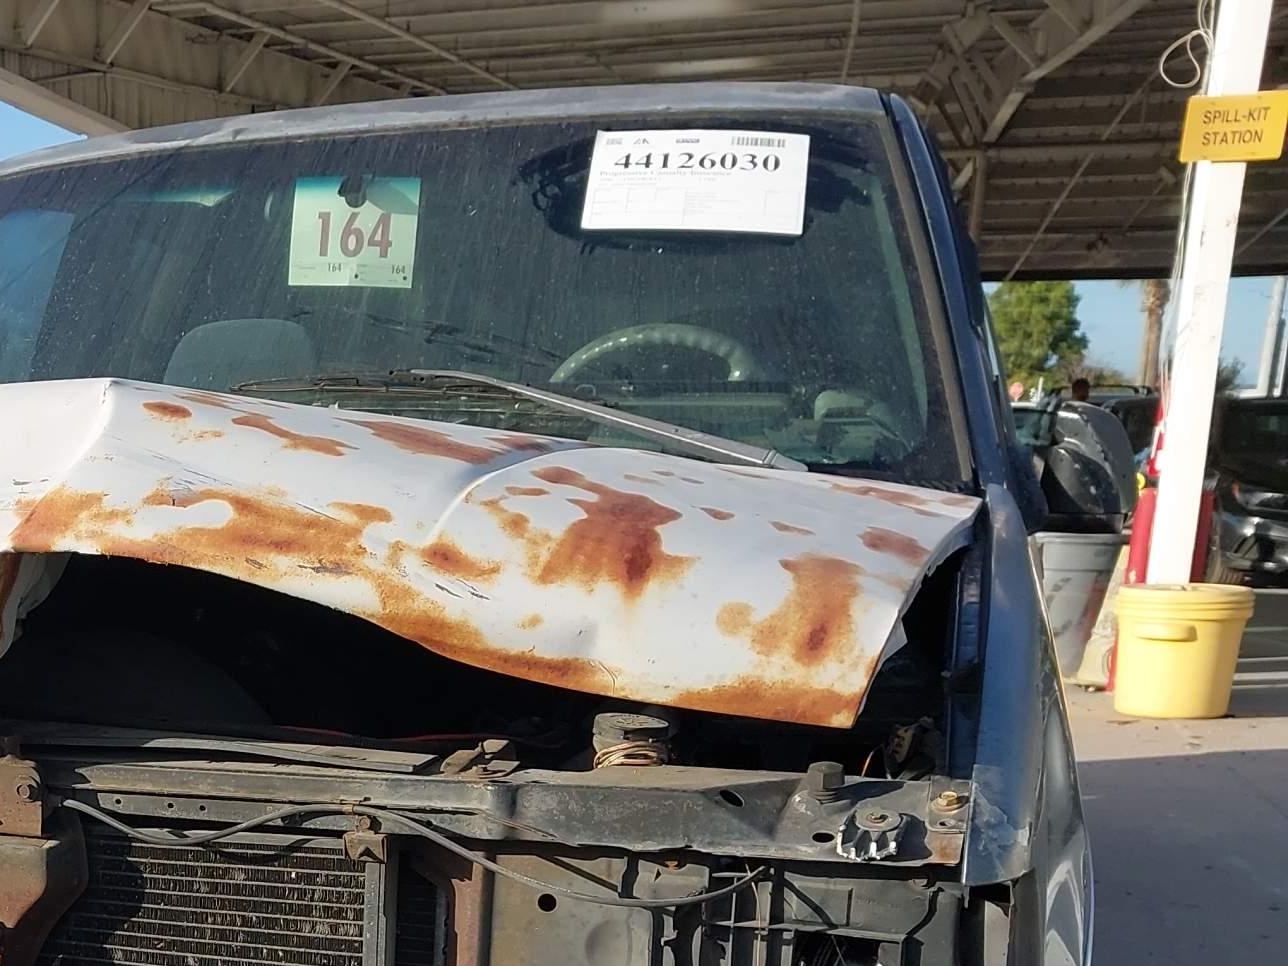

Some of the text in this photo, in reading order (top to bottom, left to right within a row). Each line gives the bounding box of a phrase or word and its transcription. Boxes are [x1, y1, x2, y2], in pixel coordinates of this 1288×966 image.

[1202, 107, 1271, 124] SPILL-KIT
[1202, 129, 1264, 146] STATION
[614, 152, 781, 172] 44126030
[318, 211, 392, 258] 164
[327, 263, 342, 272] 164
[391, 265, 405, 274] 164
